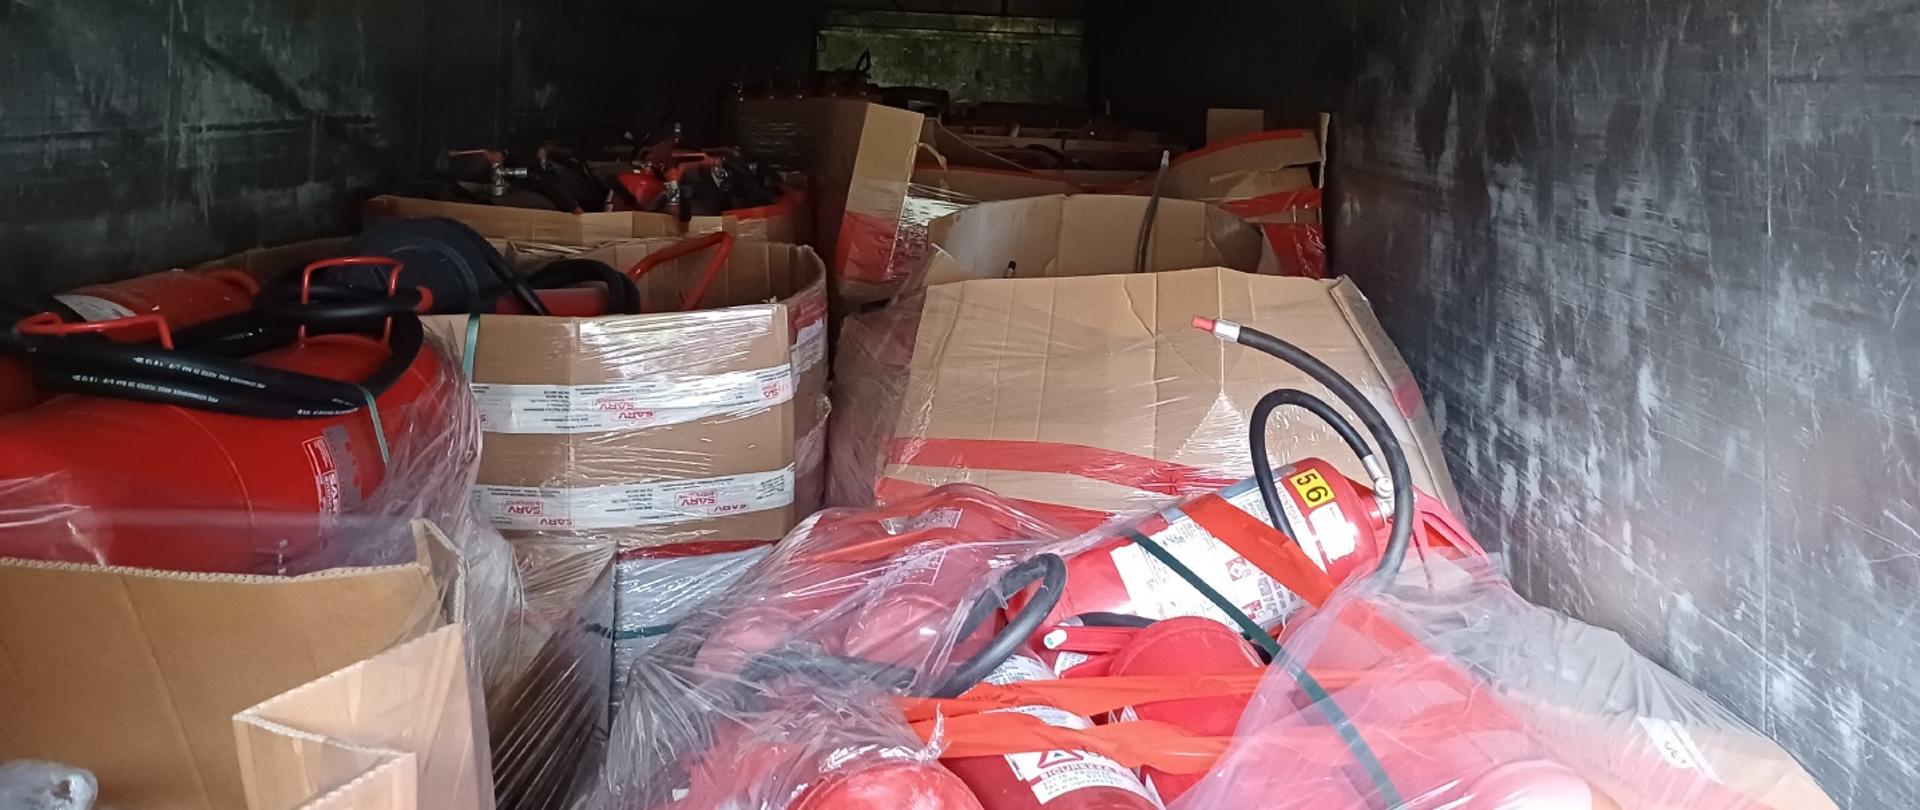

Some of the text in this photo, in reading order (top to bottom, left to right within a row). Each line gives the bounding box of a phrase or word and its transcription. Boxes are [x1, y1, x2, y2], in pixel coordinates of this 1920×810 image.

[599, 401, 634, 411] SARV
[680, 497, 716, 507] SARV
[507, 505, 541, 515] SARV
[540, 518, 573, 526] SARV
